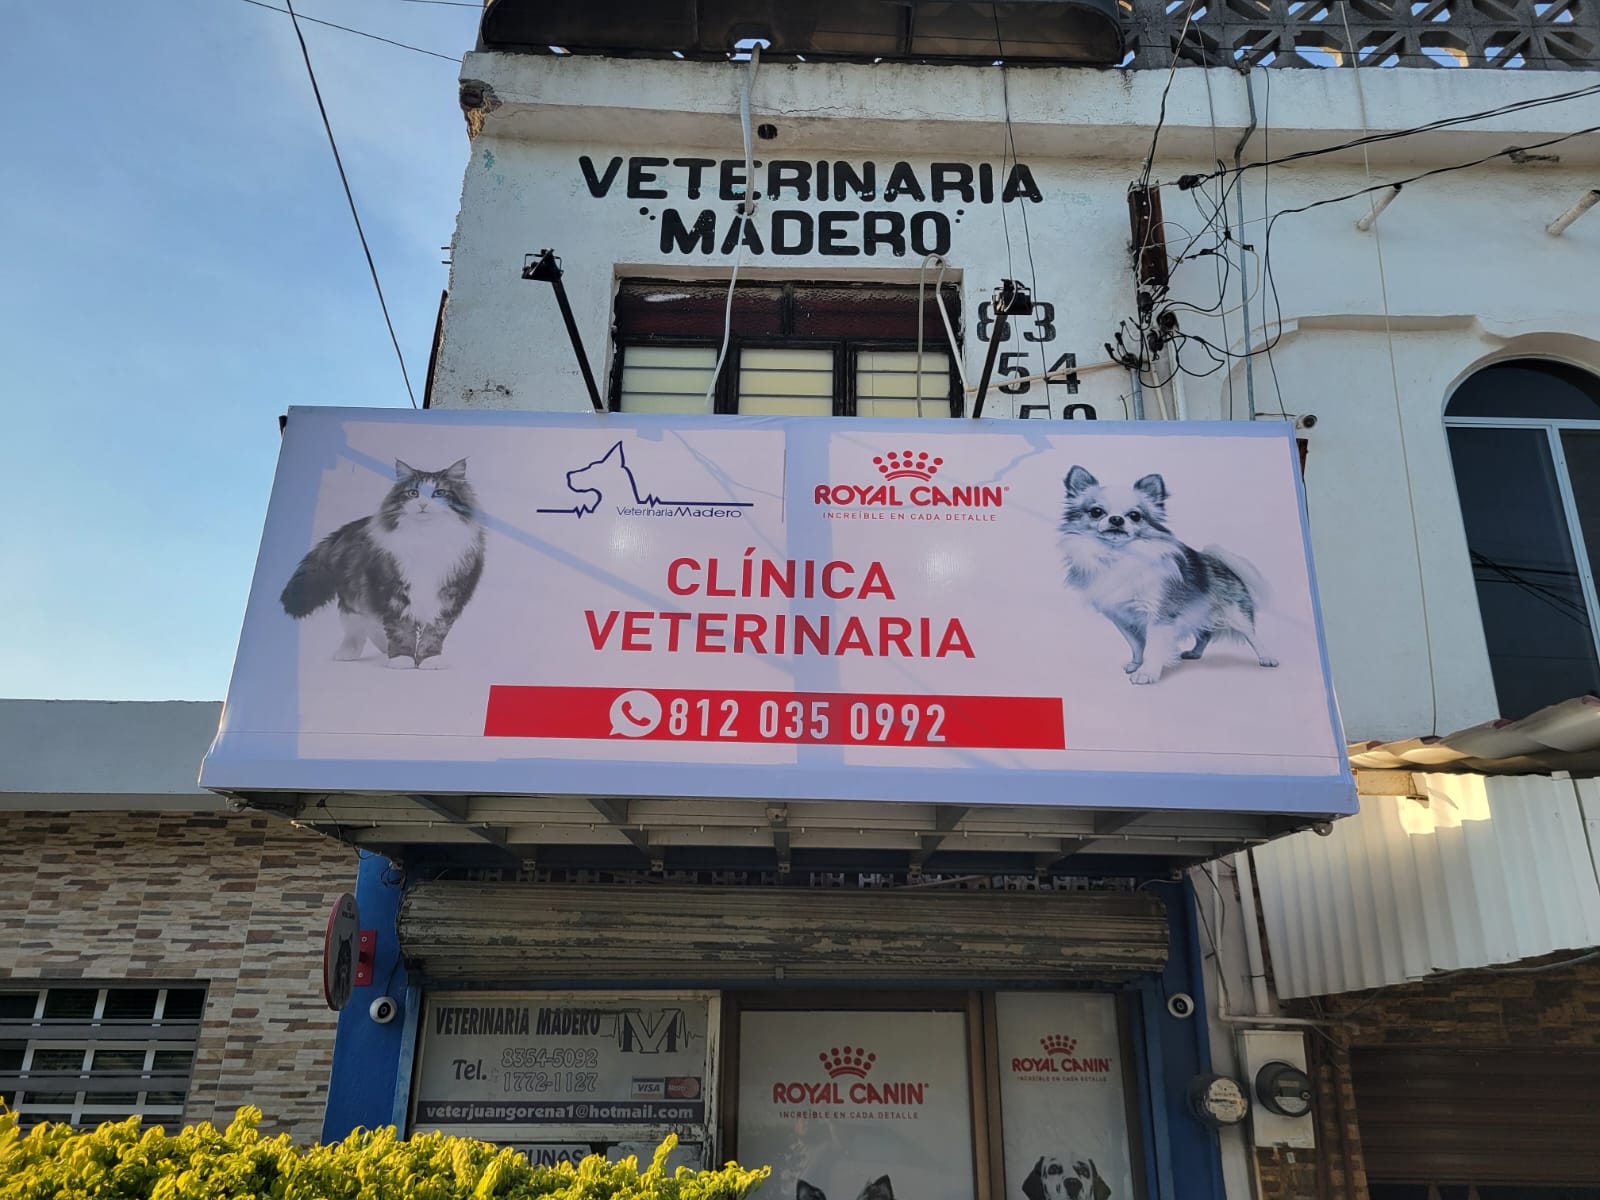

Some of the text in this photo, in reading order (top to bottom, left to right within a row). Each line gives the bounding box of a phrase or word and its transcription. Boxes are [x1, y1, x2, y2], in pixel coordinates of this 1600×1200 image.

[579, 156, 1043, 204] VETERINARIA
[977, 302, 1056, 342] 83
[998, 352, 1080, 394] 54
[815, 485, 903, 506] ROYAL
[823, 511, 998, 522] INCREÍBLE EN CADA DETALLE
[667, 547, 896, 600] CLÍNICA
[584, 610, 976, 658] VETERINARIA
[669, 698, 946, 743] 812 035 0992
[436, 1008, 600, 1036] VETERINARIA MADERO
[501, 1048, 599, 1068] 8354-5092
[1011, 1058, 1059, 1072] ROYAL
[452, 1059, 488, 1080] Tel.
[503, 1071, 599, 1092] 1772-1127
[638, 1084, 660, 1093] VISA
[773, 1082, 844, 1104] ROYAL
[426, 1104, 694, 1120] veterjuangorena1@hotmail.com
[834, 1111, 846, 1119] EN
[851, 1111, 874, 1119] CADA
[878, 1111, 919, 1120] DETALLE
